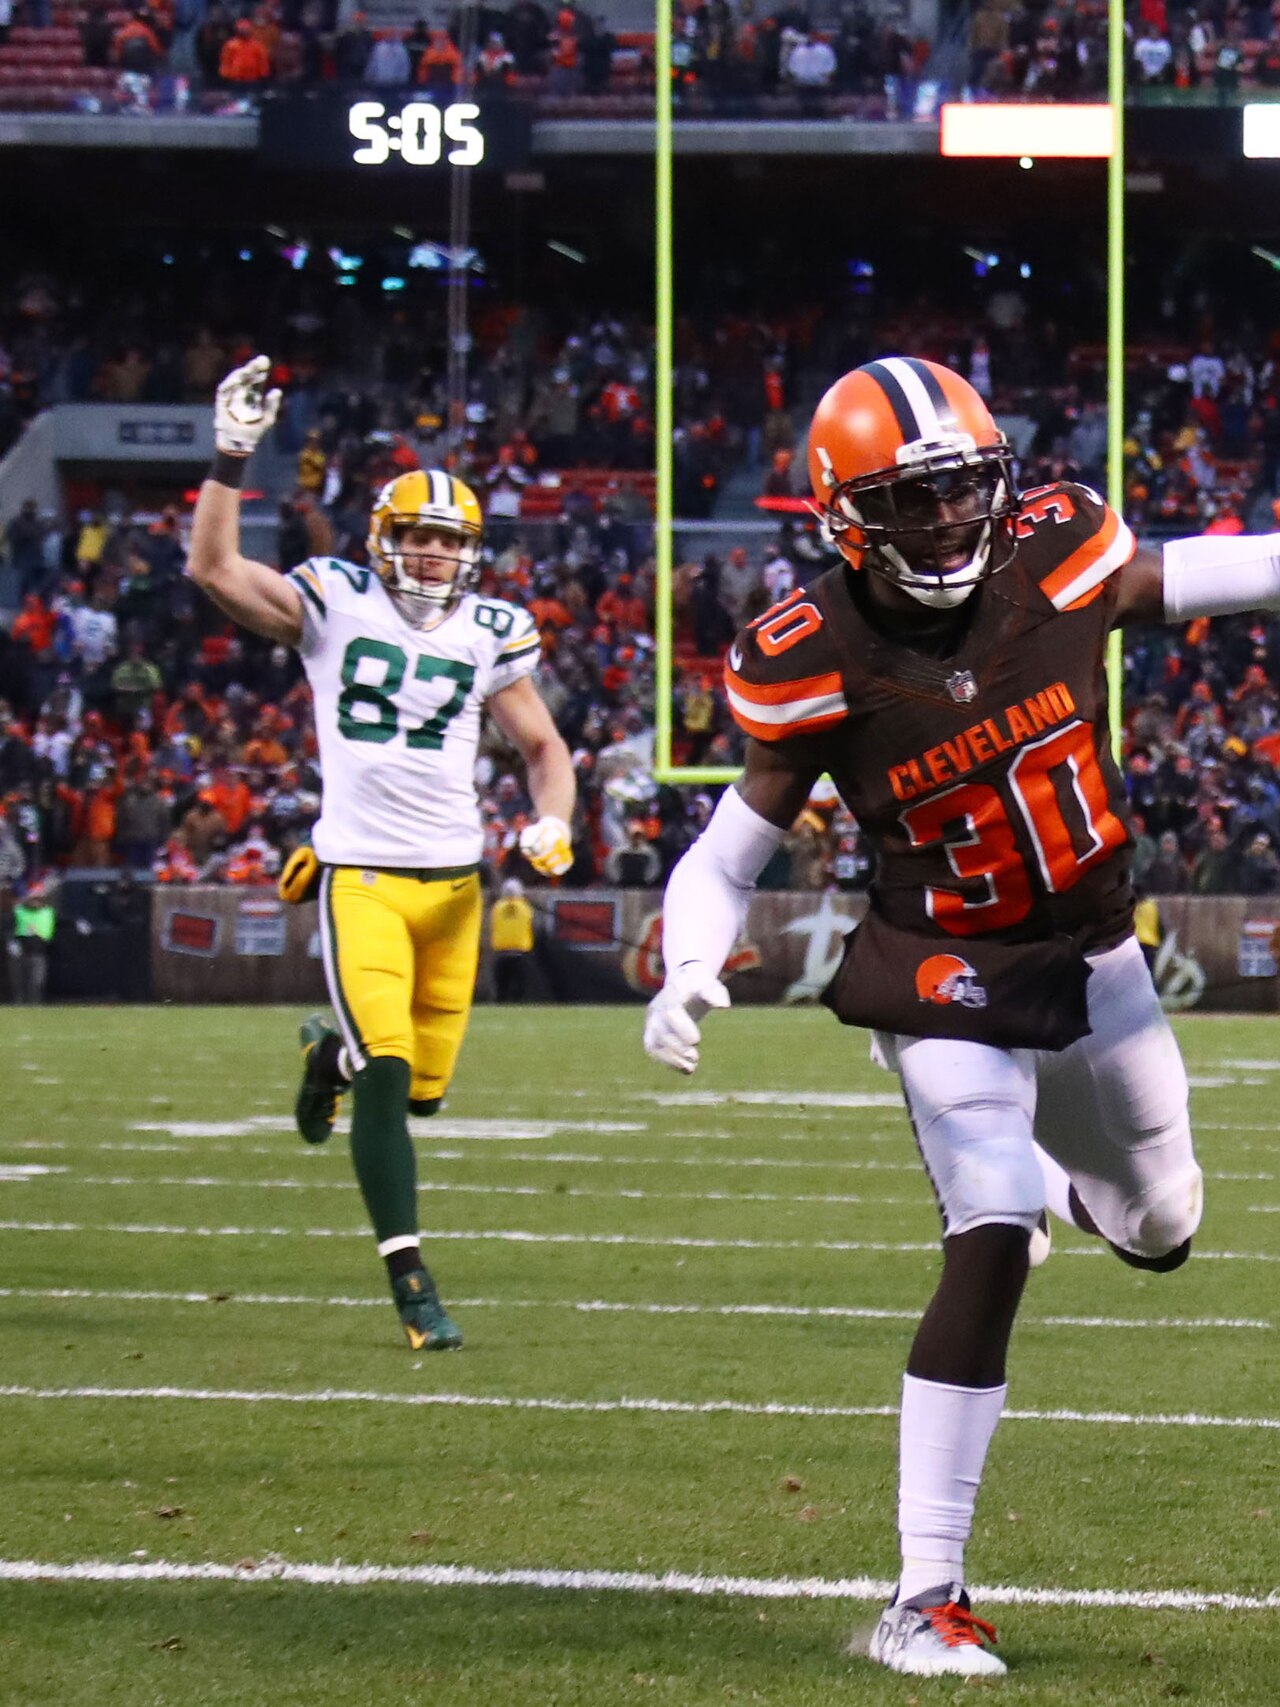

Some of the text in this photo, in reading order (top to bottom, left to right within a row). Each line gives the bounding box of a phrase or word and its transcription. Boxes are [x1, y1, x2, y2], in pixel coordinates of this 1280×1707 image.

[349, 102, 485, 166] 5:05
[337, 636, 478, 751] 87
[887, 680, 1076, 801] CLEVELAND
[898, 720, 1128, 937] 30
